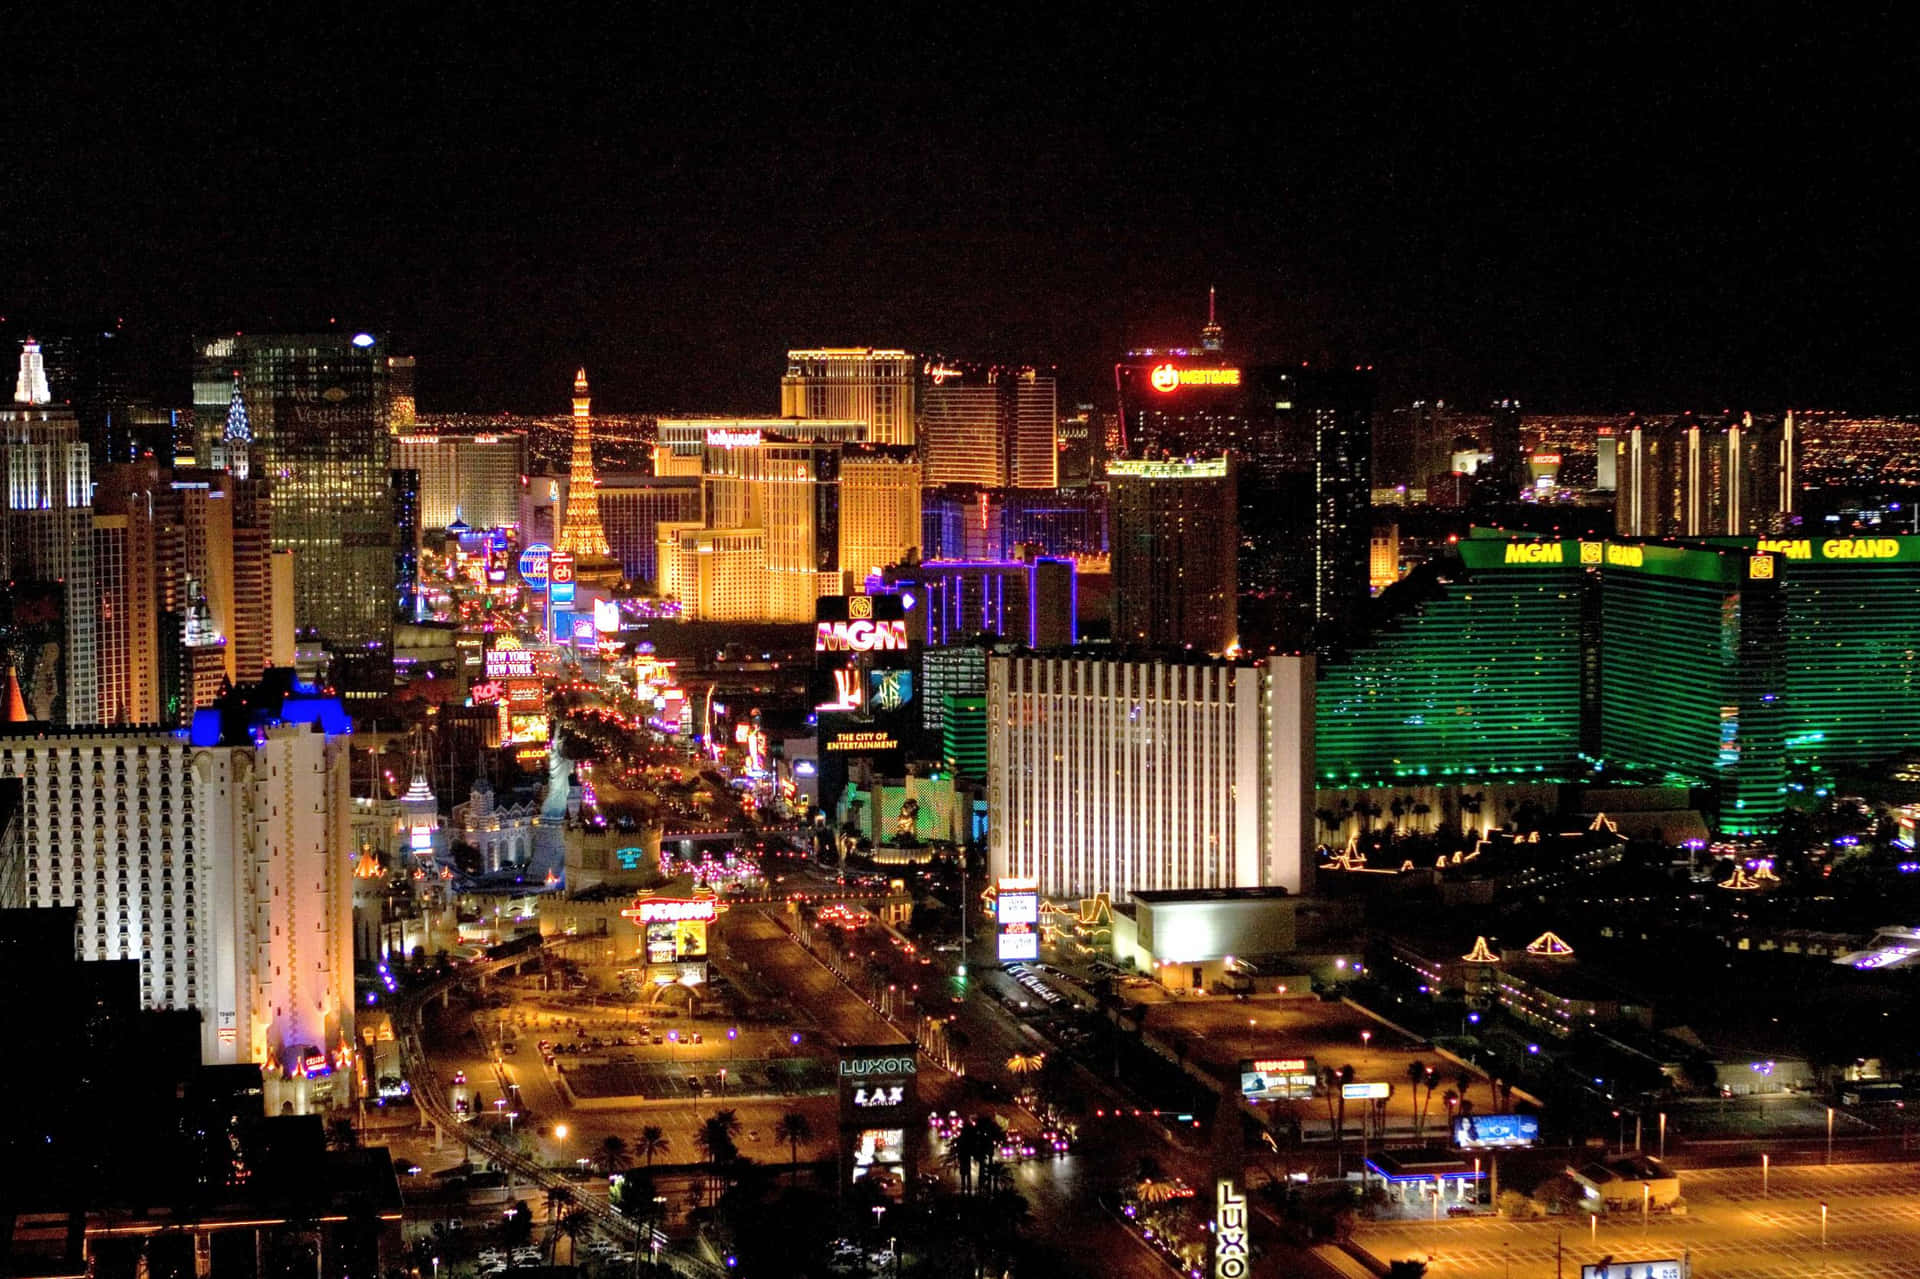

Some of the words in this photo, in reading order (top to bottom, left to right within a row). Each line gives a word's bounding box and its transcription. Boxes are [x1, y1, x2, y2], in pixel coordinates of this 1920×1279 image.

[1180, 369, 1240, 385] WESTGATE
[707, 429, 760, 451] hollywood
[1504, 543, 1563, 563] MGM
[1757, 540, 1812, 559] MGM
[1822, 539, 1900, 559] GRAND
[816, 620, 908, 651] MGM
[487, 651, 507, 662] NEW
[509, 651, 532, 662] YORK
[487, 663, 507, 674] NEW
[509, 663, 533, 674] YORK
[827, 740, 898, 750] ENTERTAINMENT
[837, 733, 854, 741] THE
[855, 733, 874, 741] CITY
[876, 732, 888, 740] OF
[840, 1057, 917, 1076] LUXOR
[855, 1086, 904, 1104] LAX
